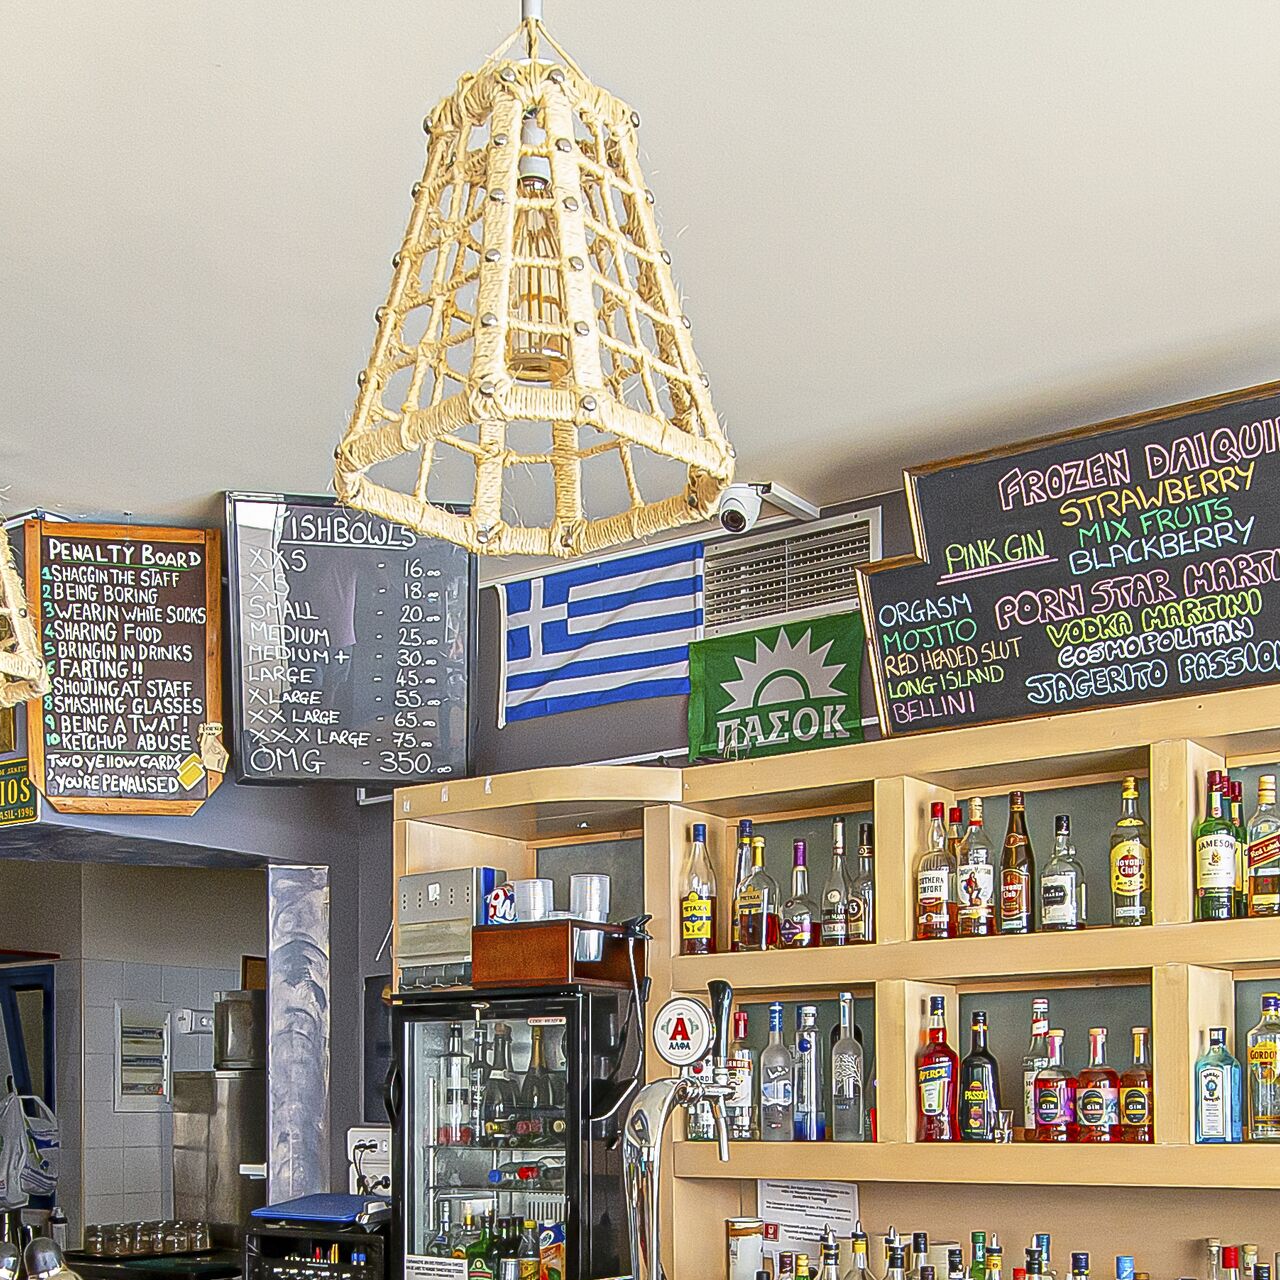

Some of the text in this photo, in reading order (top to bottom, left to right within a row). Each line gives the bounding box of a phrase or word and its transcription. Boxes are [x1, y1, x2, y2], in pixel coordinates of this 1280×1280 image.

[998, 448, 1130, 511] FROZEN
[1060, 461, 1255, 527] STRAWBERRY
[1078, 497, 1233, 548] MIX FRUITS
[49, 538, 201, 568] PENALTY BOARD
[945, 529, 1045, 575] PINK GIN
[1068, 515, 1255, 575] BLACKBERRY
[249, 548, 307, 572] XXS
[52, 564, 180, 588] SHAGGIN THE STAFF
[250, 573, 290, 596] XS
[42, 583, 158, 604] 2 BEING BORING
[994, 583, 1085, 630] PORN
[1090, 568, 1177, 614] STAR
[43, 602, 206, 624] 3 WEARIN WHITE SOCKS
[249, 596, 319, 621] SMALL
[879, 592, 972, 627] ORGASM
[1046, 588, 1262, 649] VODKA MARTINI
[44, 620, 162, 644] 4 SHARING FOOD
[250, 623, 330, 648] MEDIUM
[882, 618, 977, 655] MOJITO
[1057, 617, 1254, 669] COSMOPOLITAN
[44, 642, 193, 662] 5 BRINGIN IN DRINKS
[249, 646, 329, 664] MEDIUM
[884, 636, 1022, 678] RED HEADED SLUT
[53, 676, 193, 698] SHOUTING AT STAFF
[248, 665, 316, 685] LARGE
[888, 665, 1004, 699] LONG ISLAND
[1025, 659, 1168, 704] JAGERITO
[44, 696, 203, 715] 8 SMASHING GLASSES
[248, 710, 286, 724] XX
[292, 709, 340, 725] LARGE
[893, 690, 975, 724] BELLINI
[44, 714, 127, 733] 9 BEING A
[716, 703, 850, 753] ΠΑΣΟΚ
[46, 733, 192, 752] 10 KETCHUP ABUSE
[249, 728, 310, 744] XXX
[317, 729, 372, 748] LARGE
[46, 753, 183, 770] TWO CARDS
[250, 748, 326, 774] OMG
[1198, 839, 1235, 852] JAMESON
[1121, 866, 1139, 875] Club
